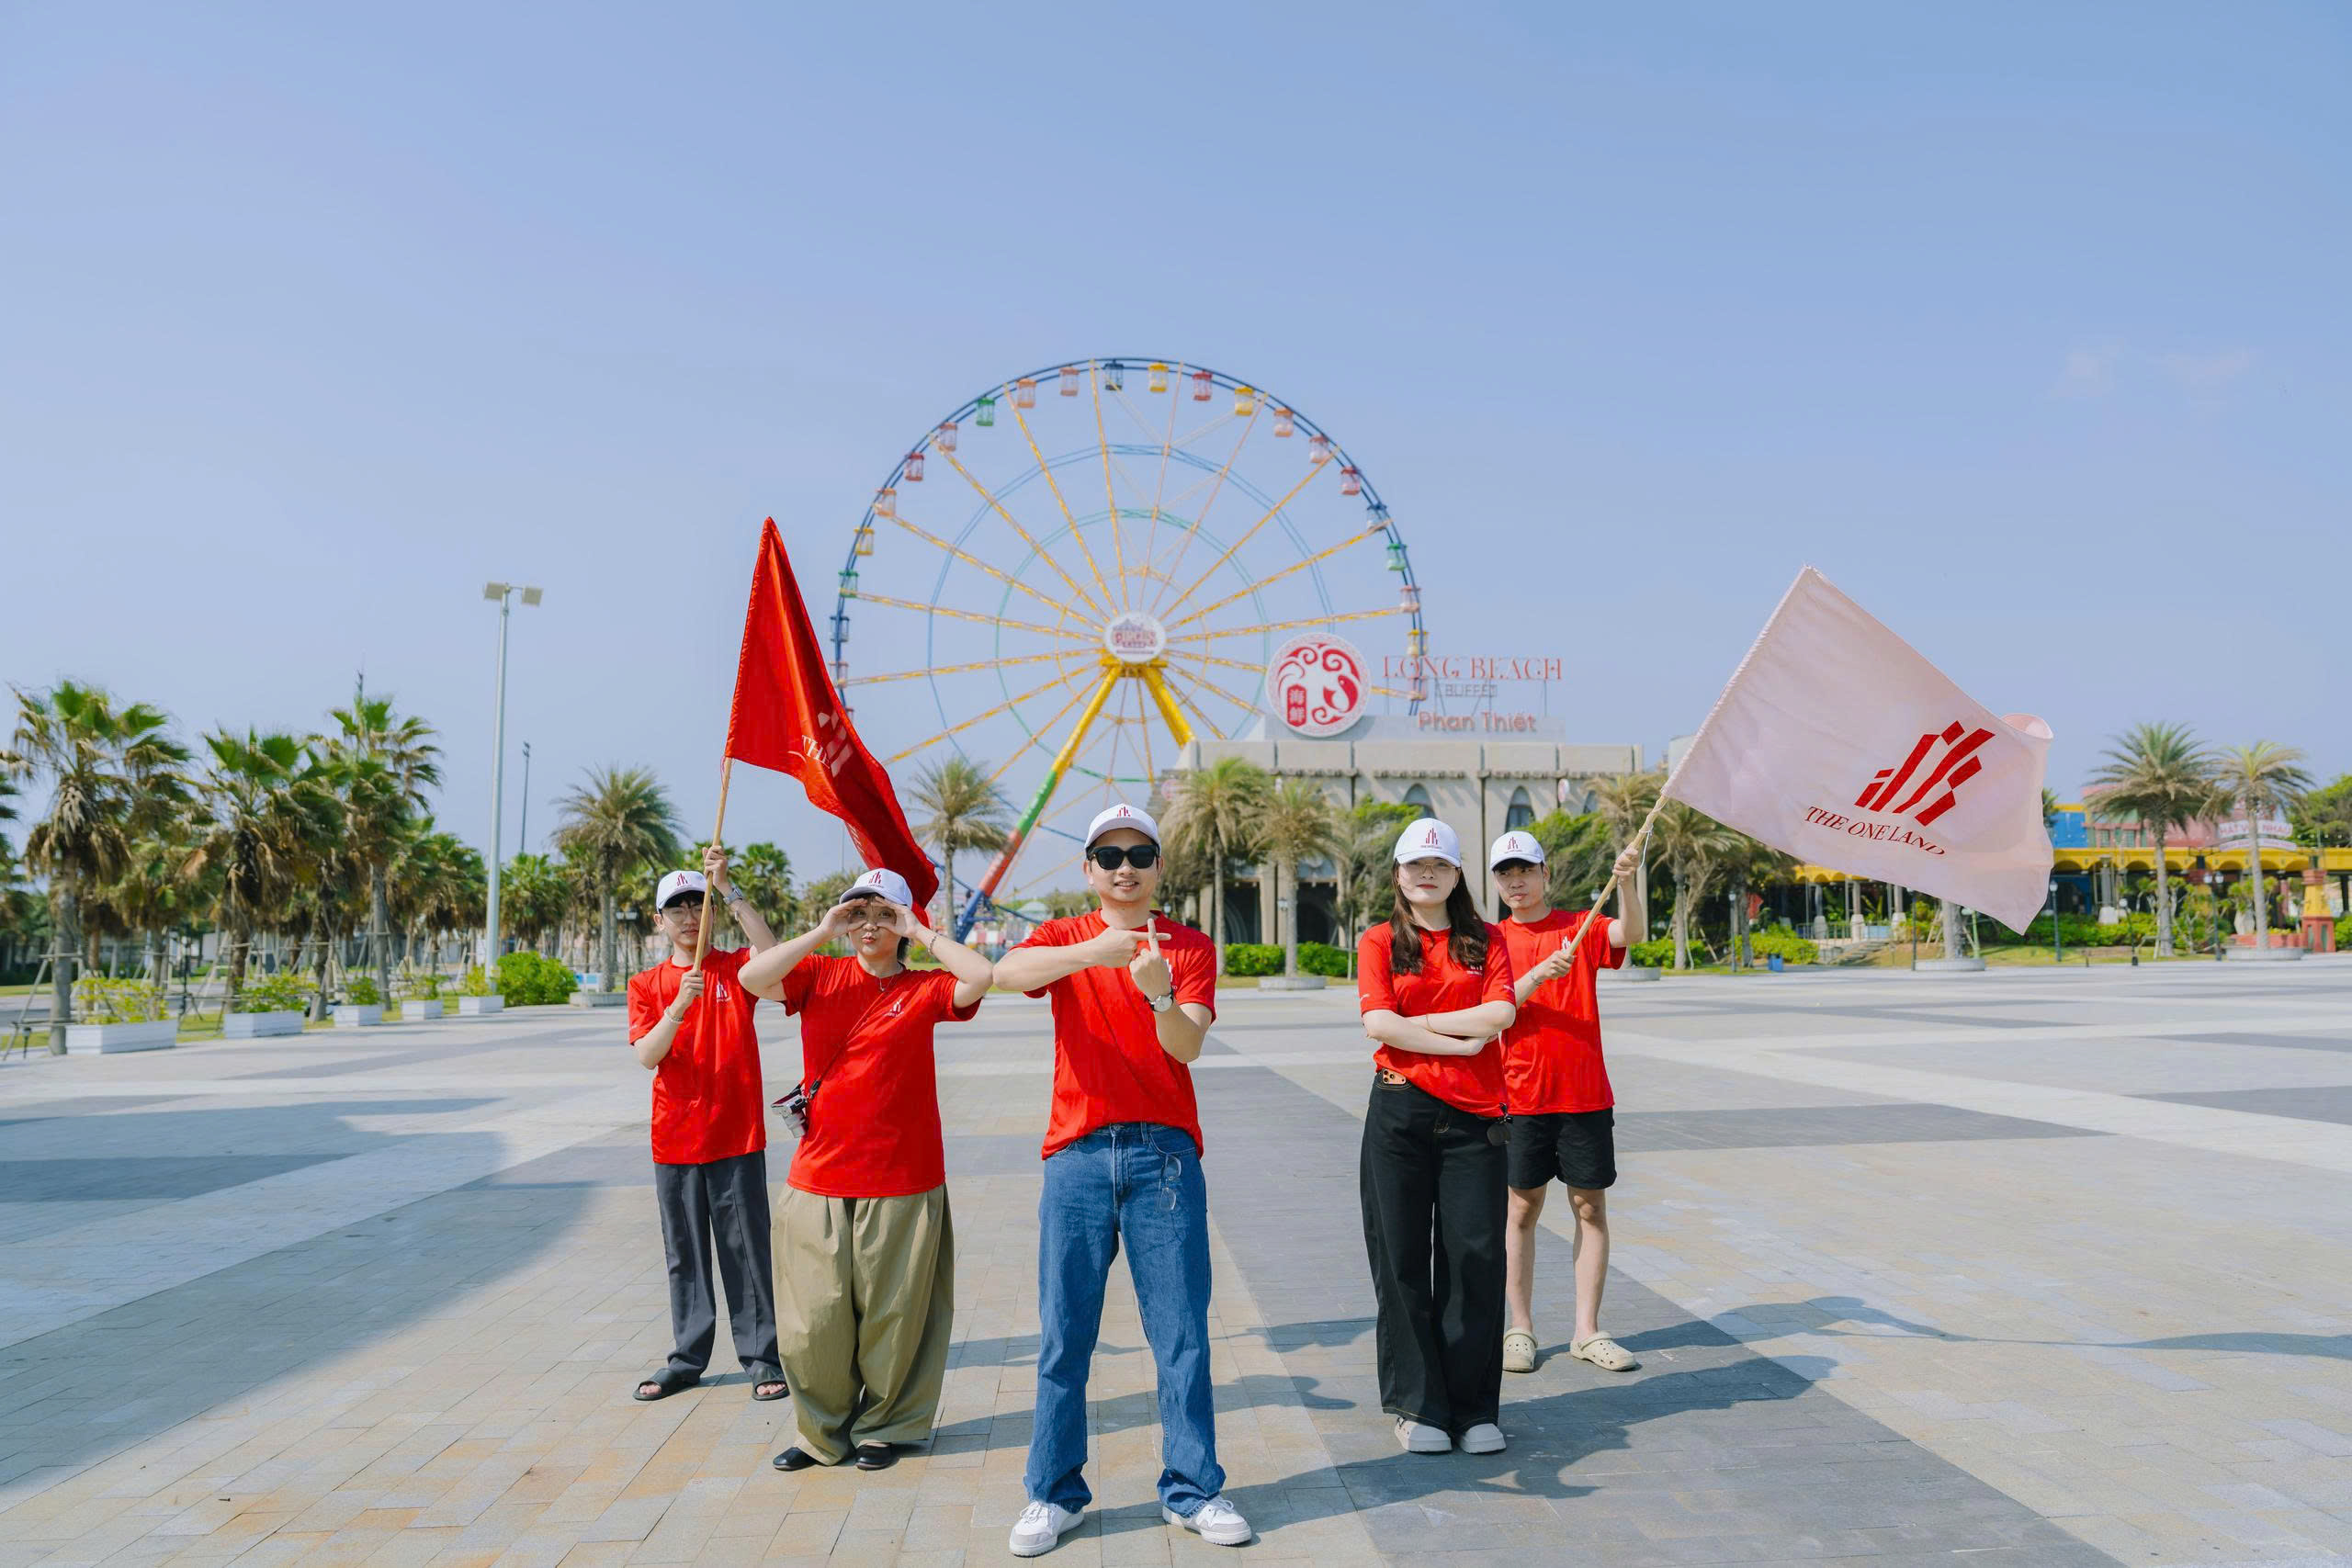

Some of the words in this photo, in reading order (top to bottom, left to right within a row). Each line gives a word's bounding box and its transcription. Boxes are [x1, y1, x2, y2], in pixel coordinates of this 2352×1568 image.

[1419, 711, 1475, 731] Phan
[1804, 806, 1849, 830] THE
[1847, 821, 1890, 840] ONE
[1884, 826, 1946, 855] LAND
